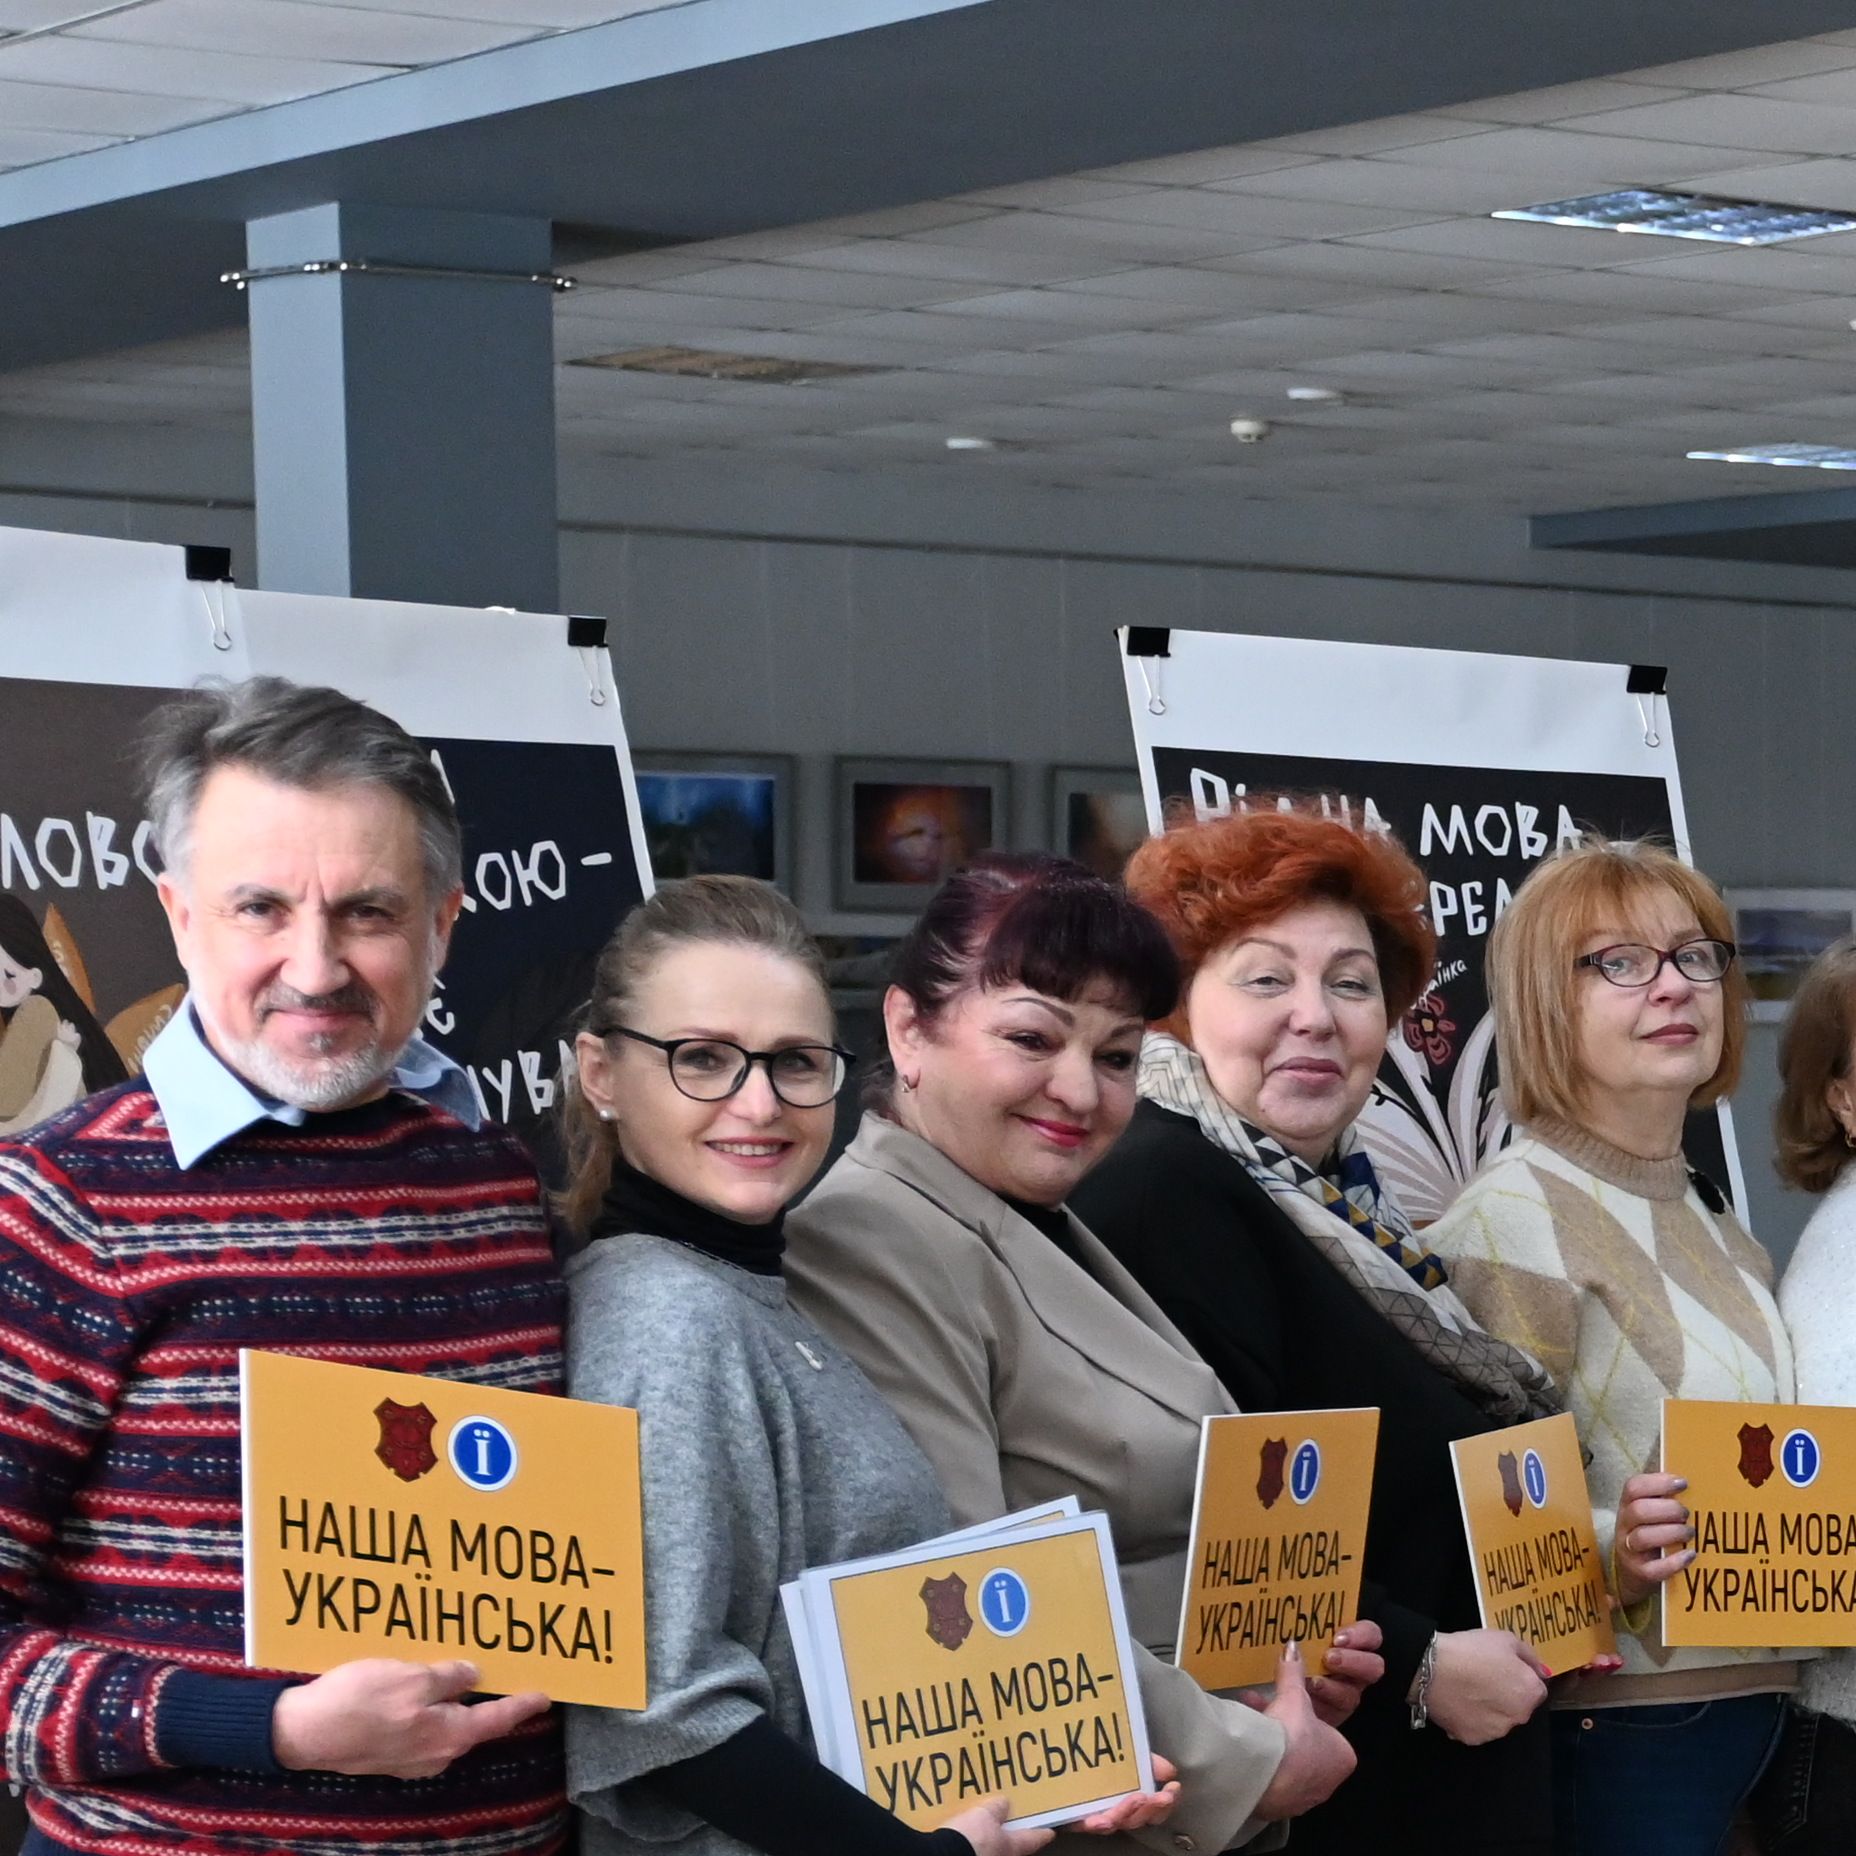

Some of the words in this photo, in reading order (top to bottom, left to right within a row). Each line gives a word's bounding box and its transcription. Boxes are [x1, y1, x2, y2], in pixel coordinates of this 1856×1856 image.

[1420, 801, 1584, 860] МОВА
[462, 840, 567, 913] ОЮ
[279, 1496, 432, 1569] НАША
[1202, 1537, 1270, 1589] НАША
[1483, 1541, 1537, 1597] НАША
[282, 1569, 614, 1665] УКРАЇНСЬКА!
[1195, 1587, 1346, 1655] УКРАЇНСЬКА!
[862, 1677, 984, 1750] НАША
[874, 1711, 1126, 1815] УКРАЇНСЬКА!
